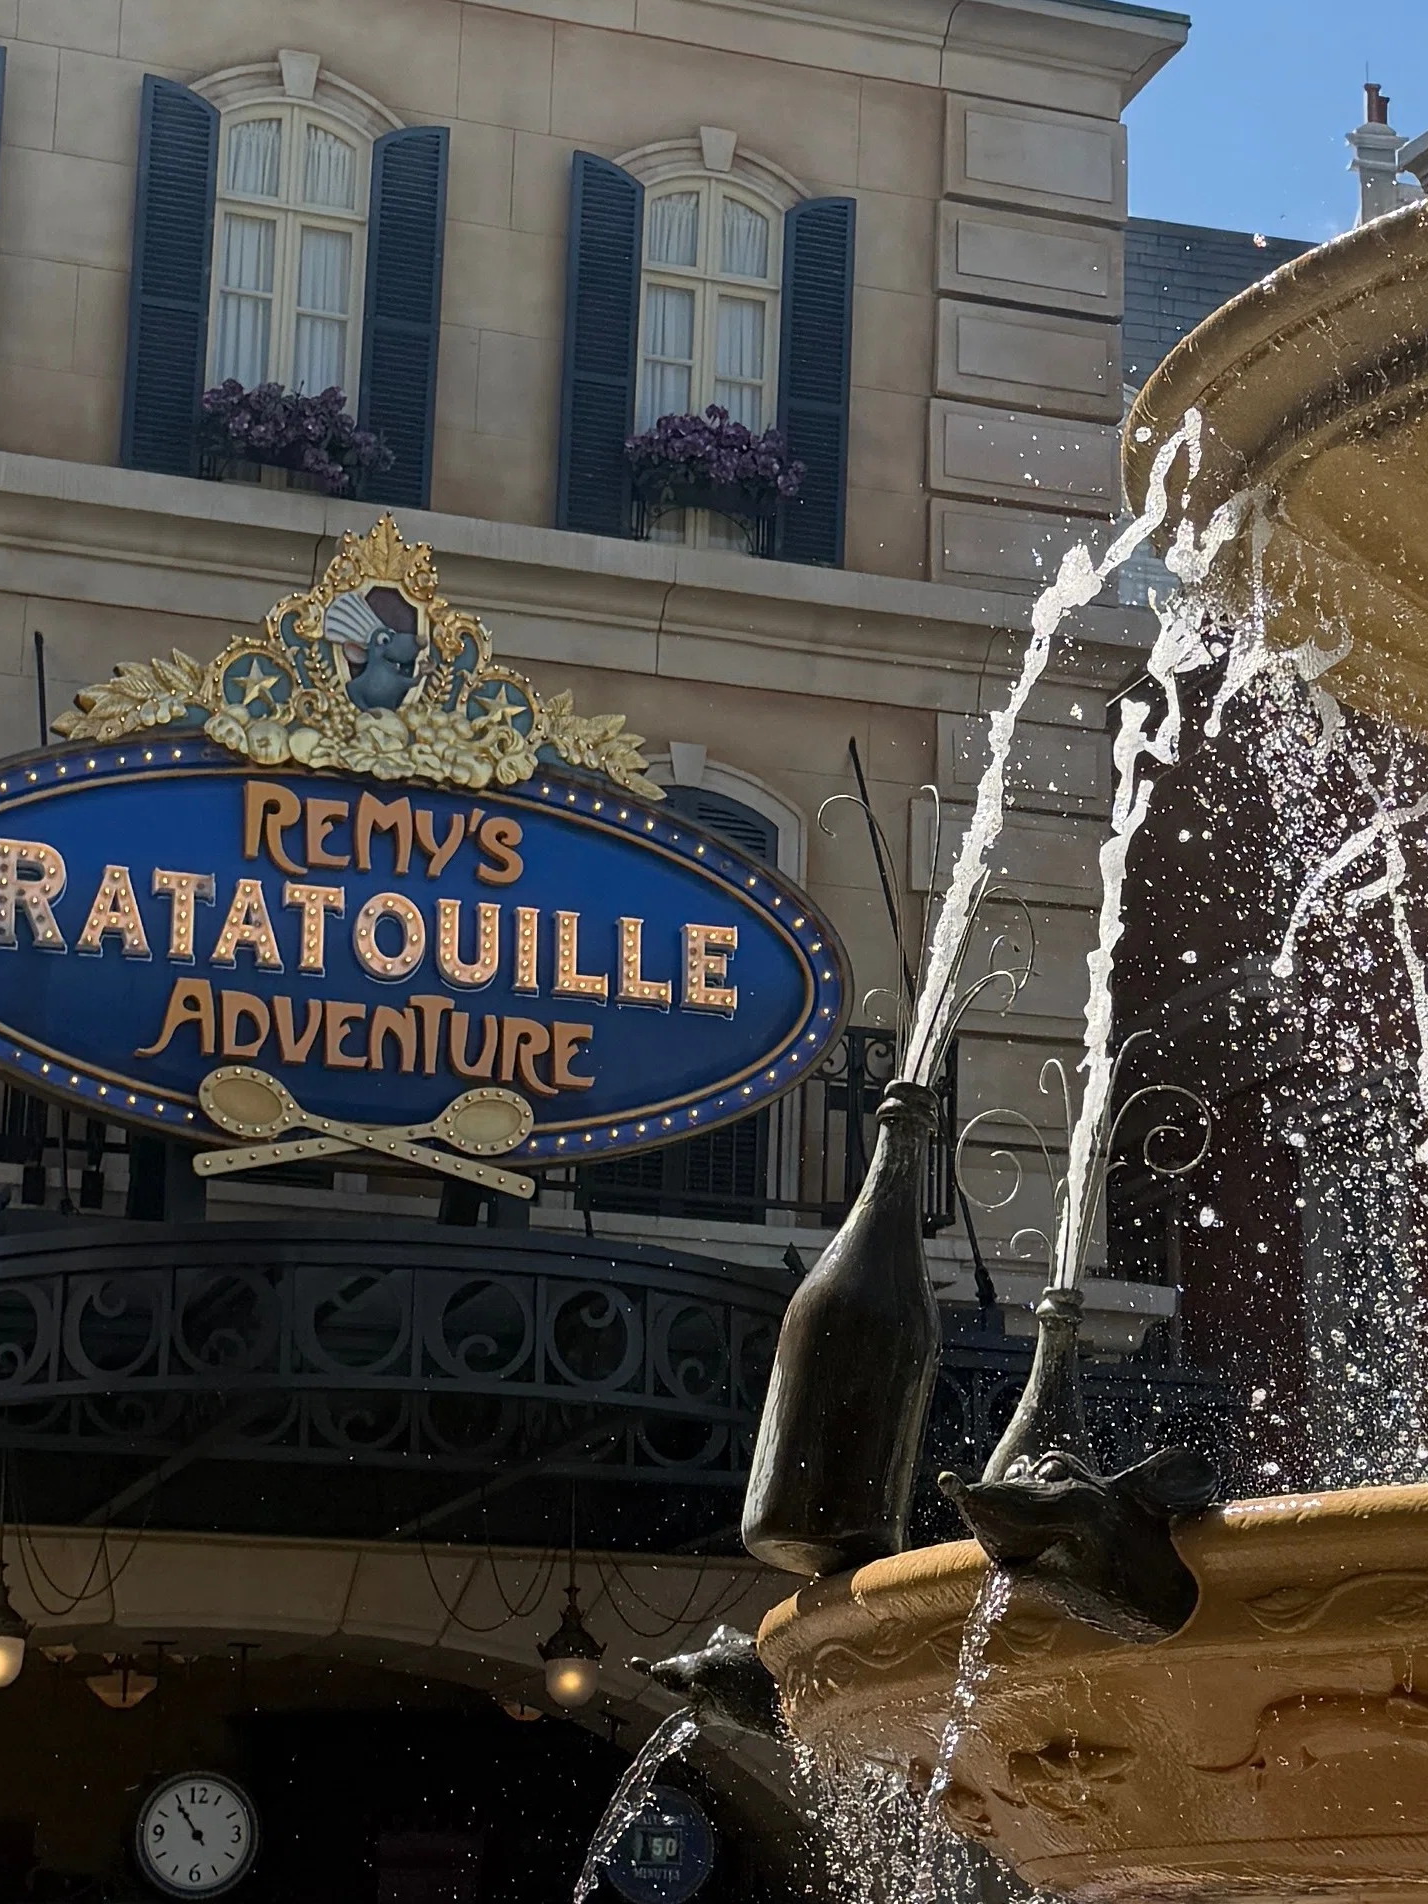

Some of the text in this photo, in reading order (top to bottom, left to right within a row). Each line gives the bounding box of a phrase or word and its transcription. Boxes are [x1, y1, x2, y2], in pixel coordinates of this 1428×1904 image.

[243, 779, 525, 885] REMY'S
[134, 978, 597, 1095] ADVENTURE
[190, 1787, 209, 1805] 12
[152, 1824, 165, 1843] 9
[230, 1825, 242, 1844] 3
[651, 1837, 678, 1857] 50
[188, 1864, 201, 1883] 6
